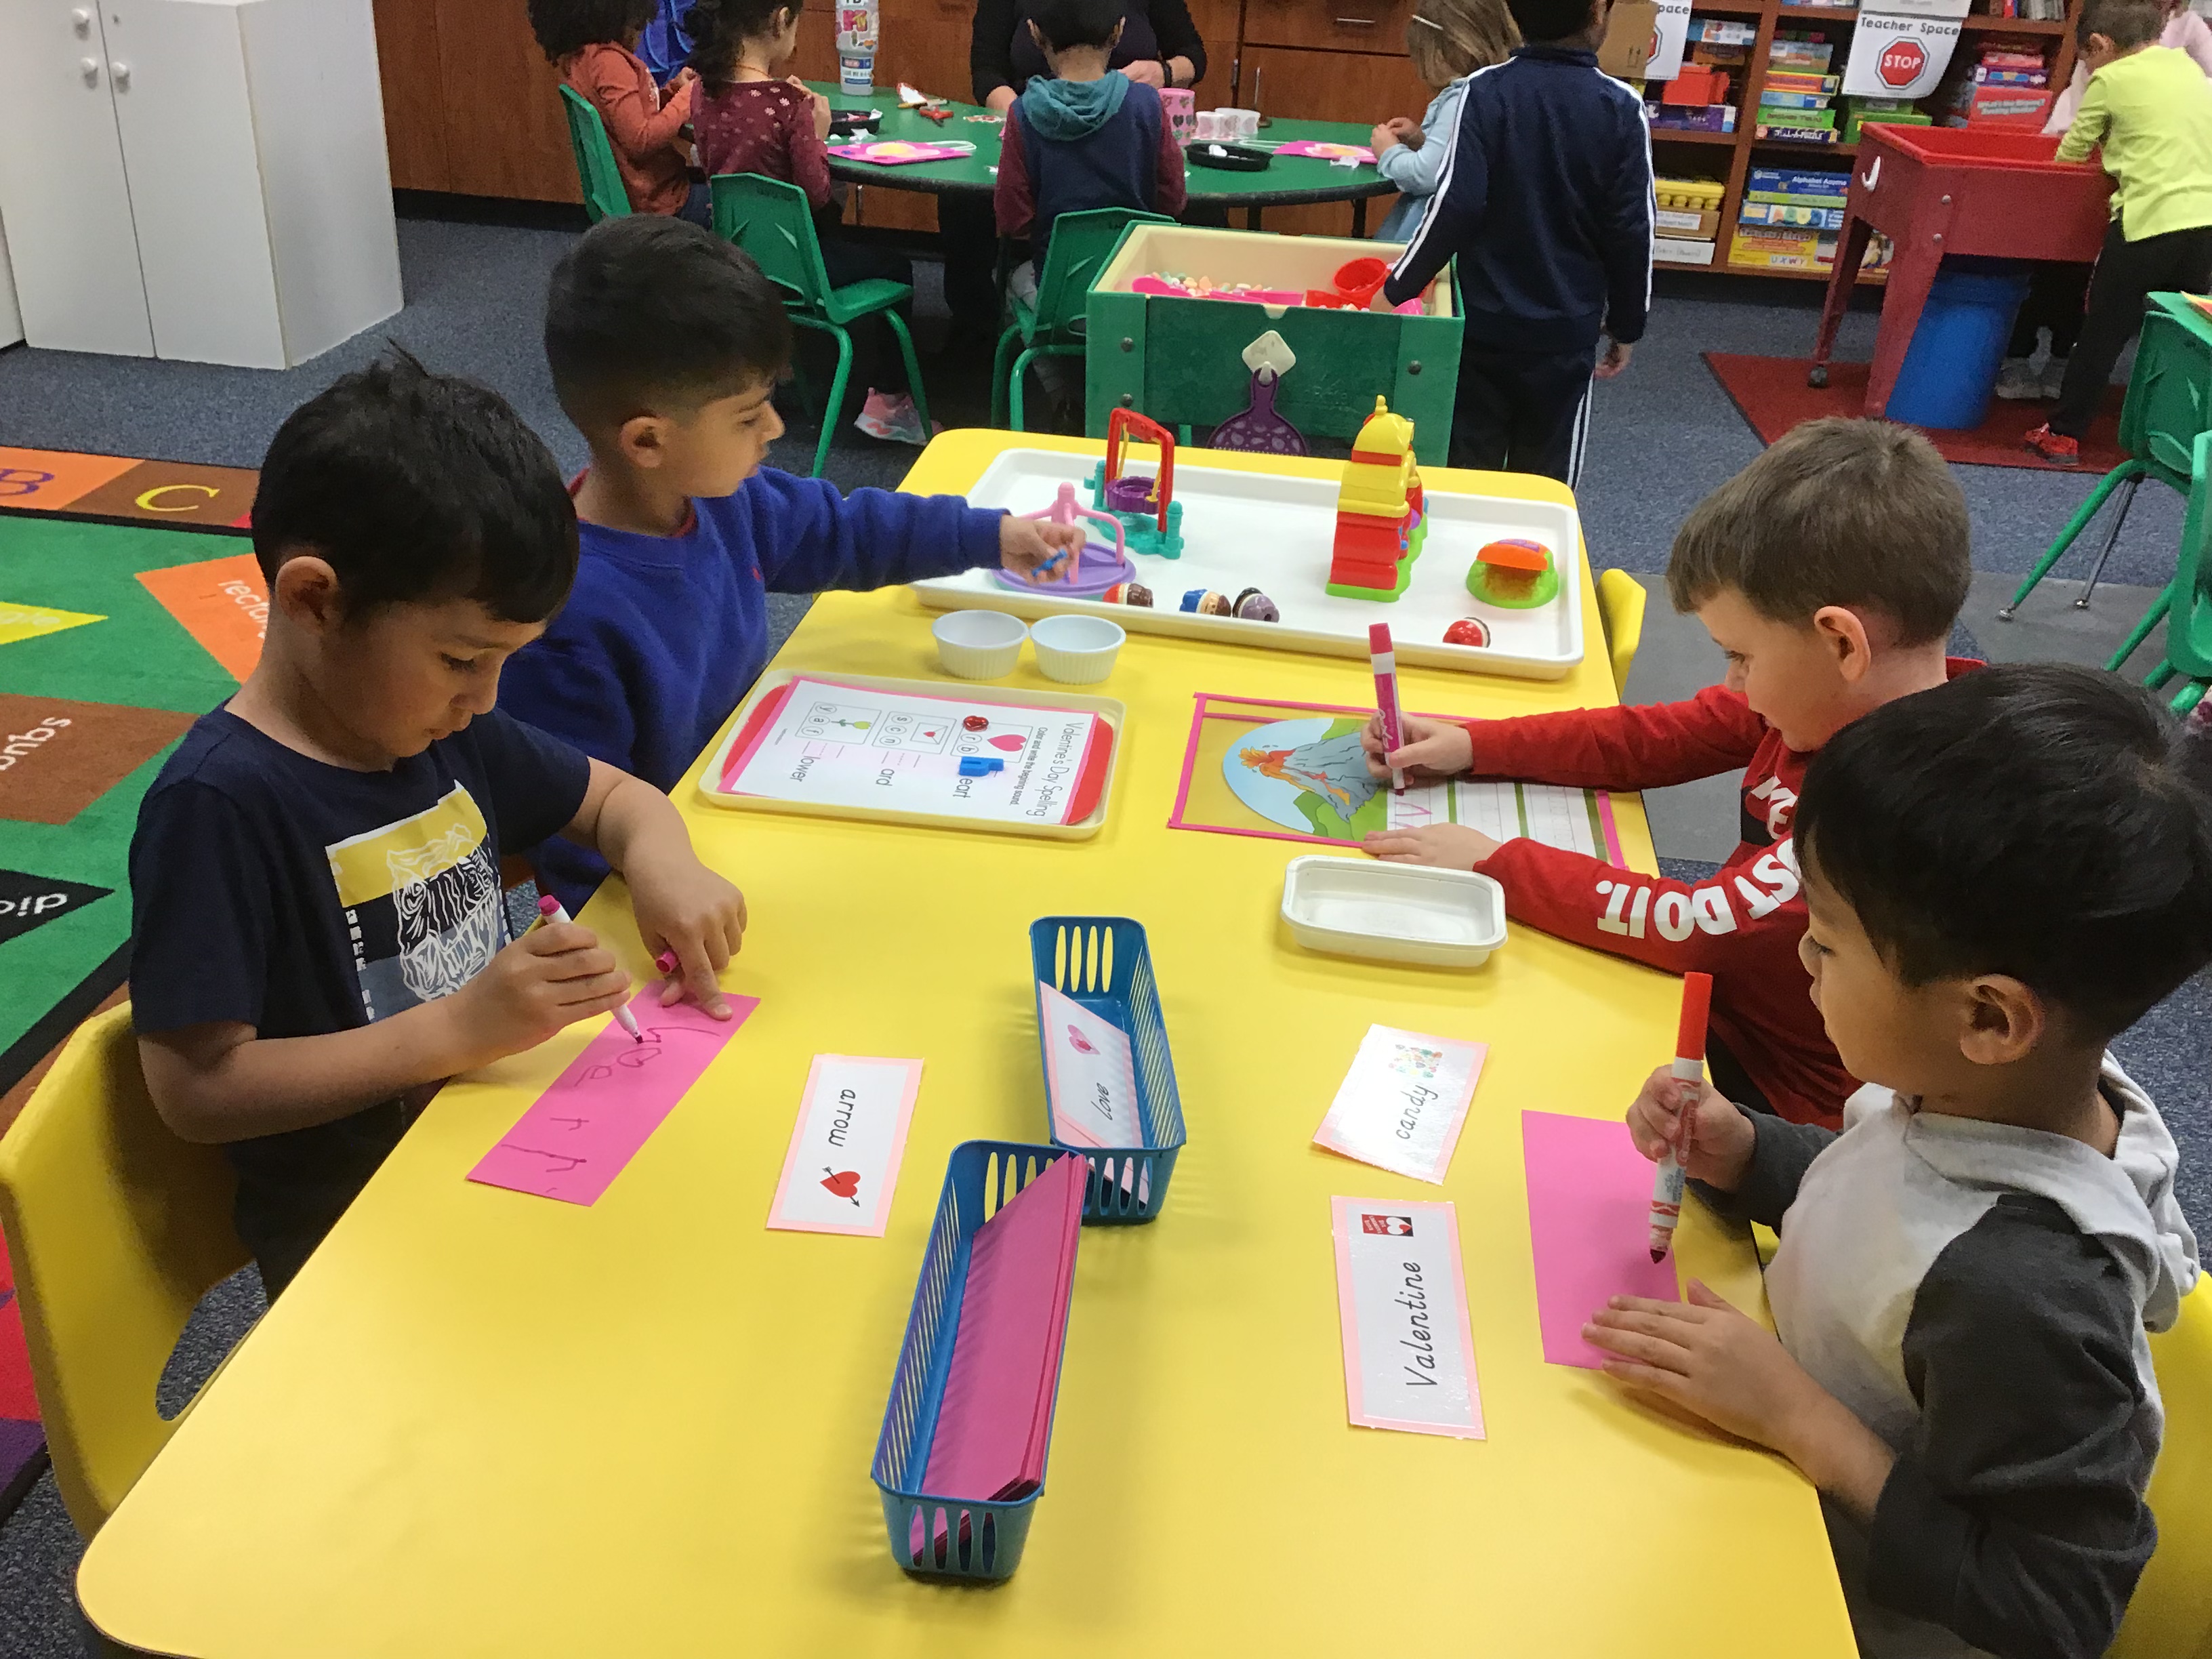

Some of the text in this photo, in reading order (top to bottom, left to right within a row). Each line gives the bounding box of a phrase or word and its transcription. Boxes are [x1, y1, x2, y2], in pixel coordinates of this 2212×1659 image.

[1658, 3, 1689, 15] pace
[1861, 17, 1960, 35] Teacher Space
[1884, 54, 1921, 70] STOP
[135, 484, 220, 512] C
[1031, 739, 1042, 750] and
[1036, 726, 1048, 740] Color
[790, 755, 821, 783] lower
[875, 767, 896, 787] ard
[1023, 761, 1036, 770] the
[1025, 722, 1084, 817] Valentine's Day Spelling
[952, 778, 973, 799] eart
[1734, 838, 1802, 920] ST
[1654, 885, 1738, 942] DO
[1090, 1082, 1113, 1121] love
[1395, 1084, 1439, 1140] candy
[827, 1088, 856, 1147] arrow
[1393, 1261, 1438, 1387] Valentine
